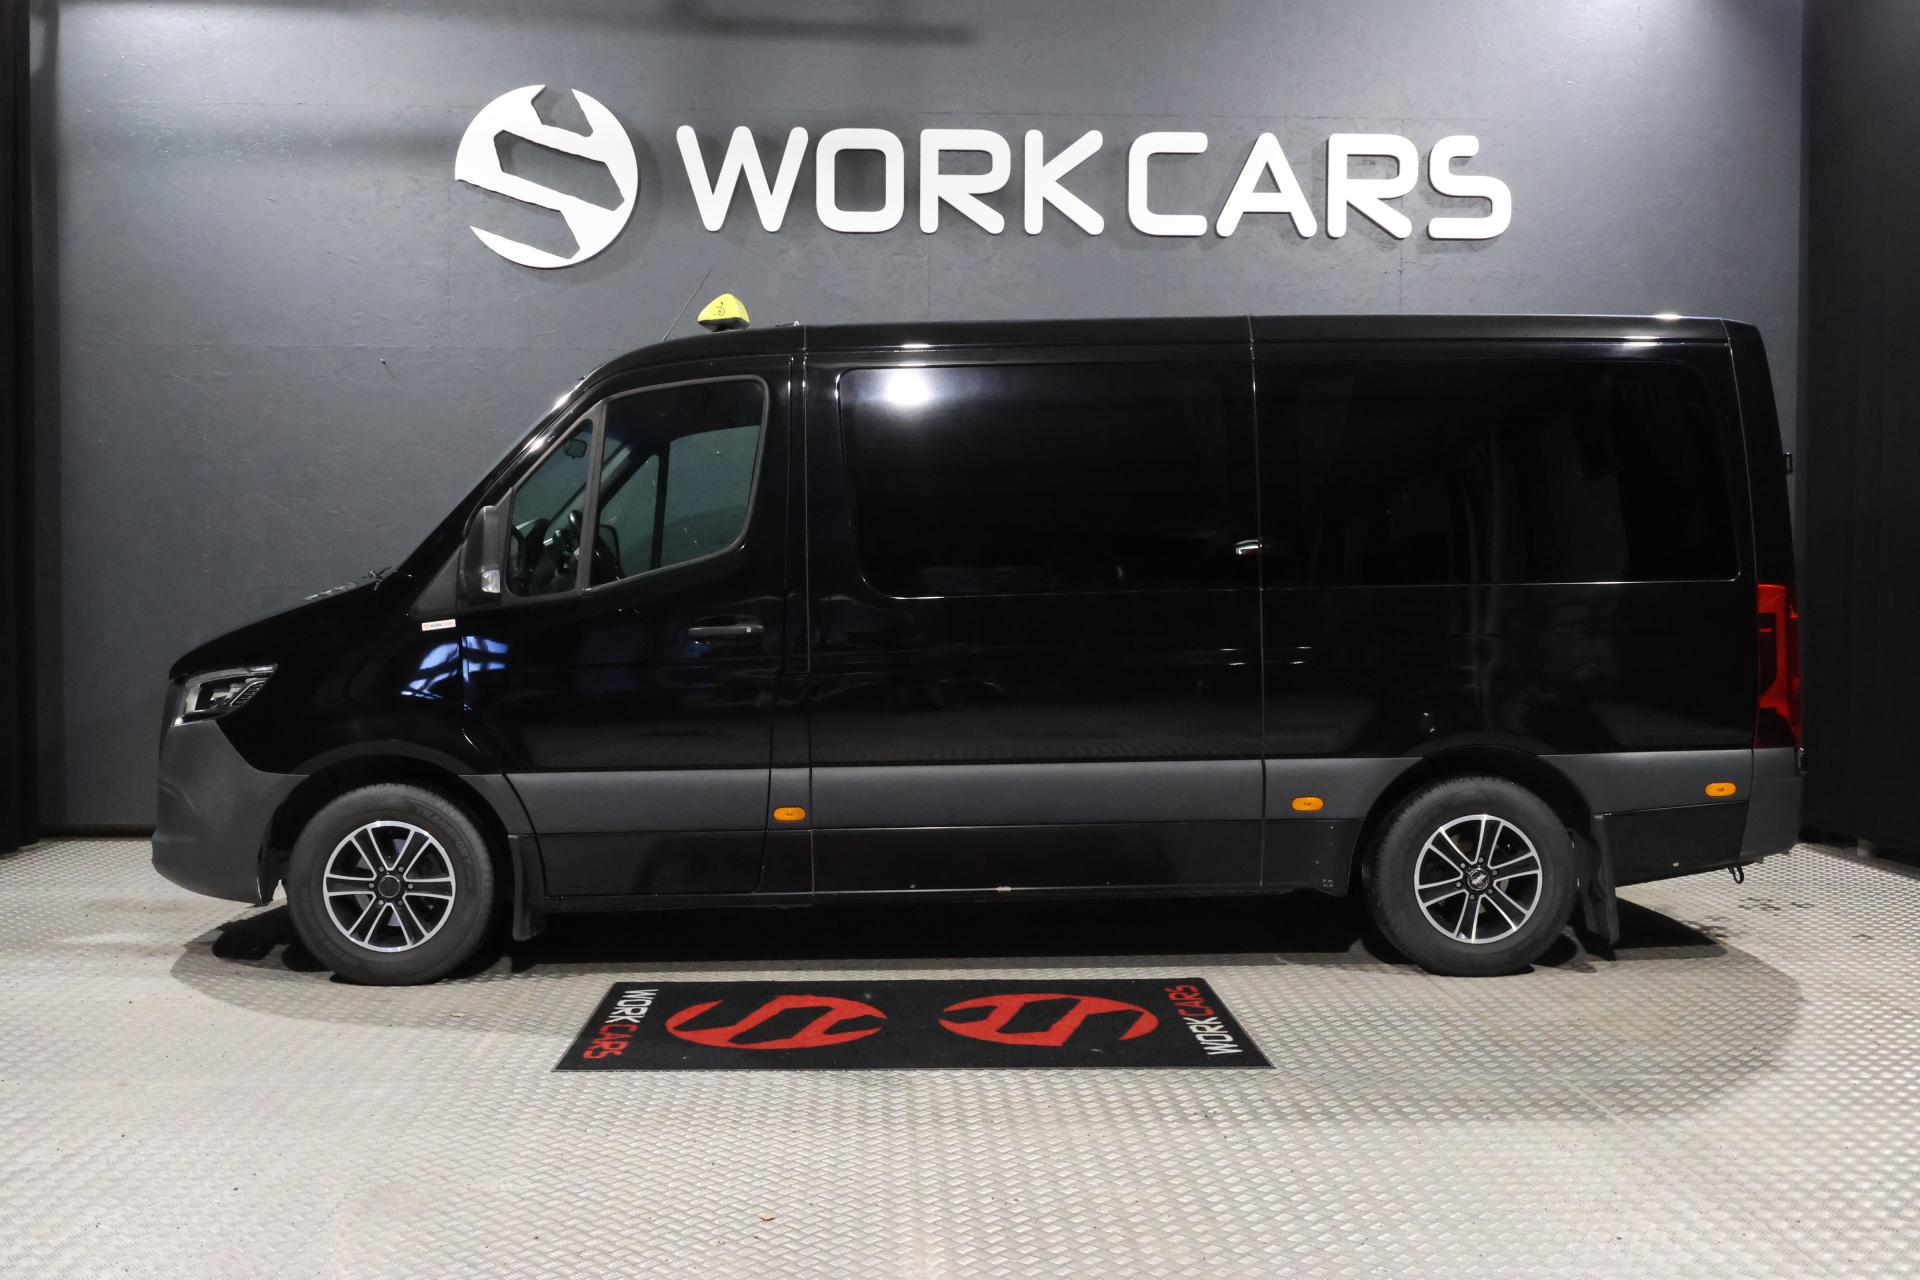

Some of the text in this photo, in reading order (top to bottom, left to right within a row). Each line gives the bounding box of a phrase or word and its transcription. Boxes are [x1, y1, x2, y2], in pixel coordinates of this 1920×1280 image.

[676, 125, 1513, 239] WORK CARS
[583, 988, 659, 1059] WORK CARS
[1165, 985, 1243, 1055] WORK CARS
